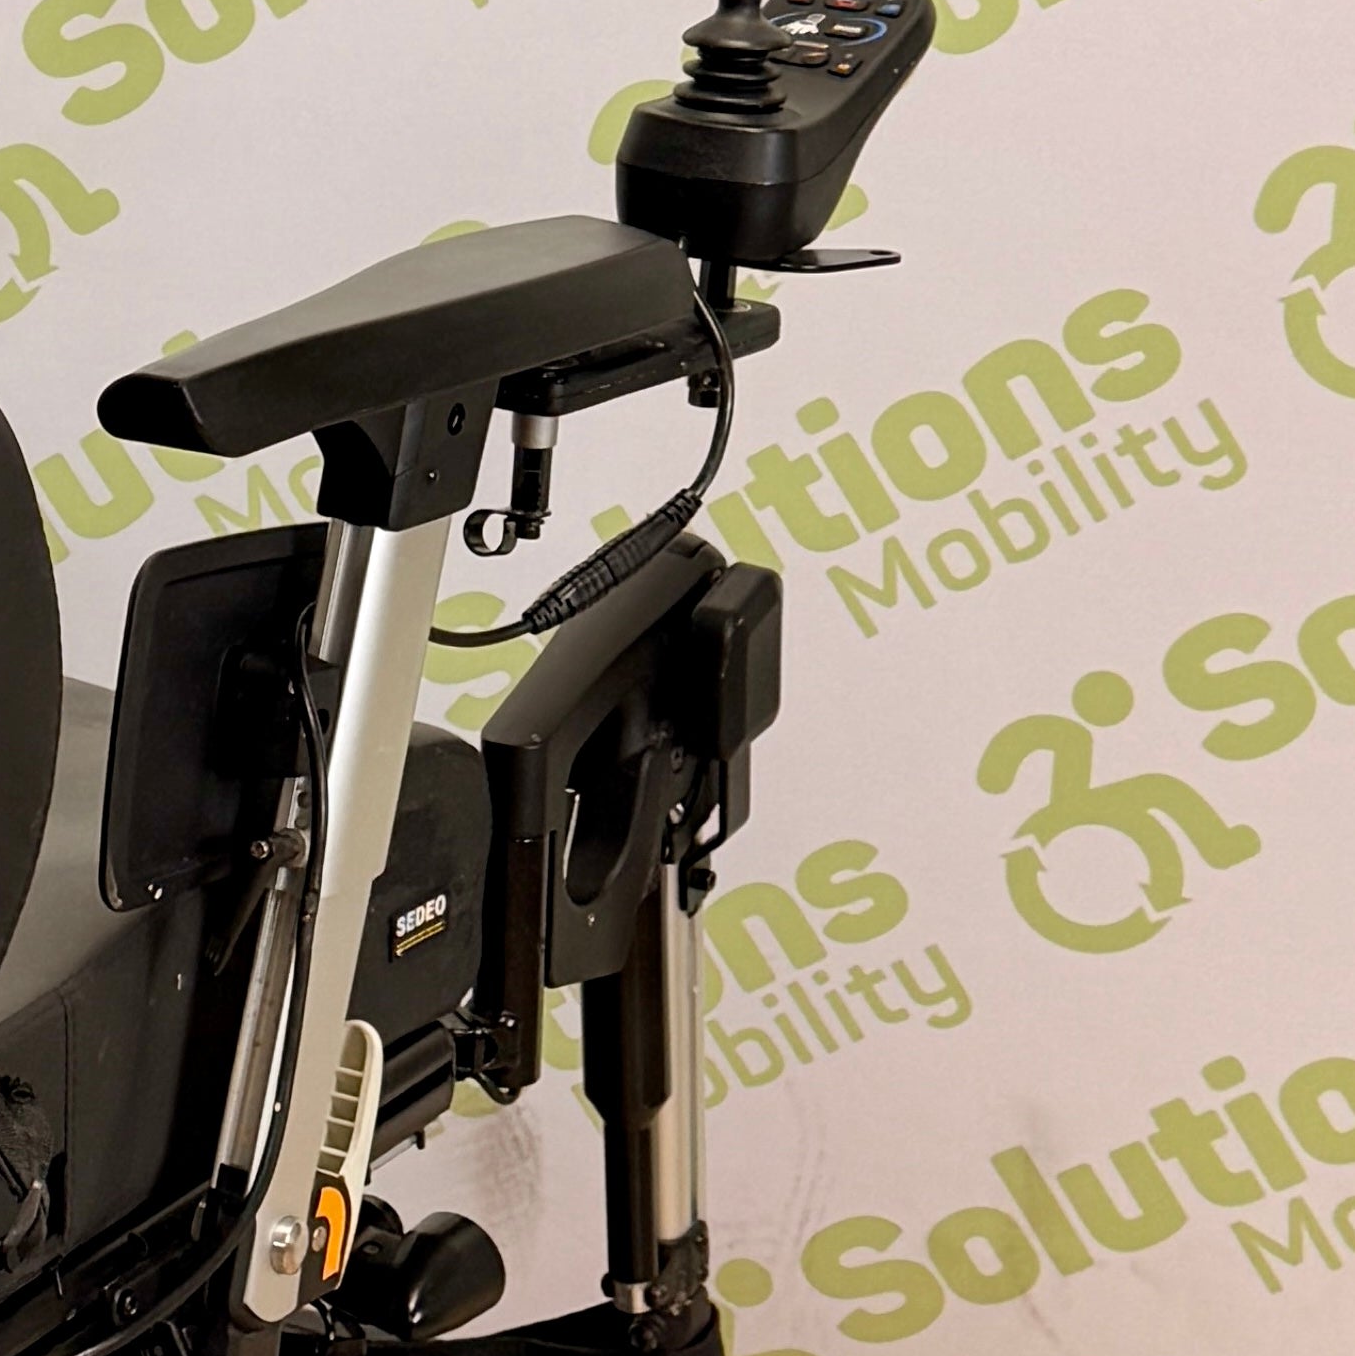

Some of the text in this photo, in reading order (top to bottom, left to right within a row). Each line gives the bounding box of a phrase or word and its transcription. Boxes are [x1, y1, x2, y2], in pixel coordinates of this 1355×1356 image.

[826, 399, 1248, 639] Mobility
[395, 894, 447, 938] SEDEO
[702, 943, 973, 1110] bility
[800, 1054, 1355, 1342] Solutio
